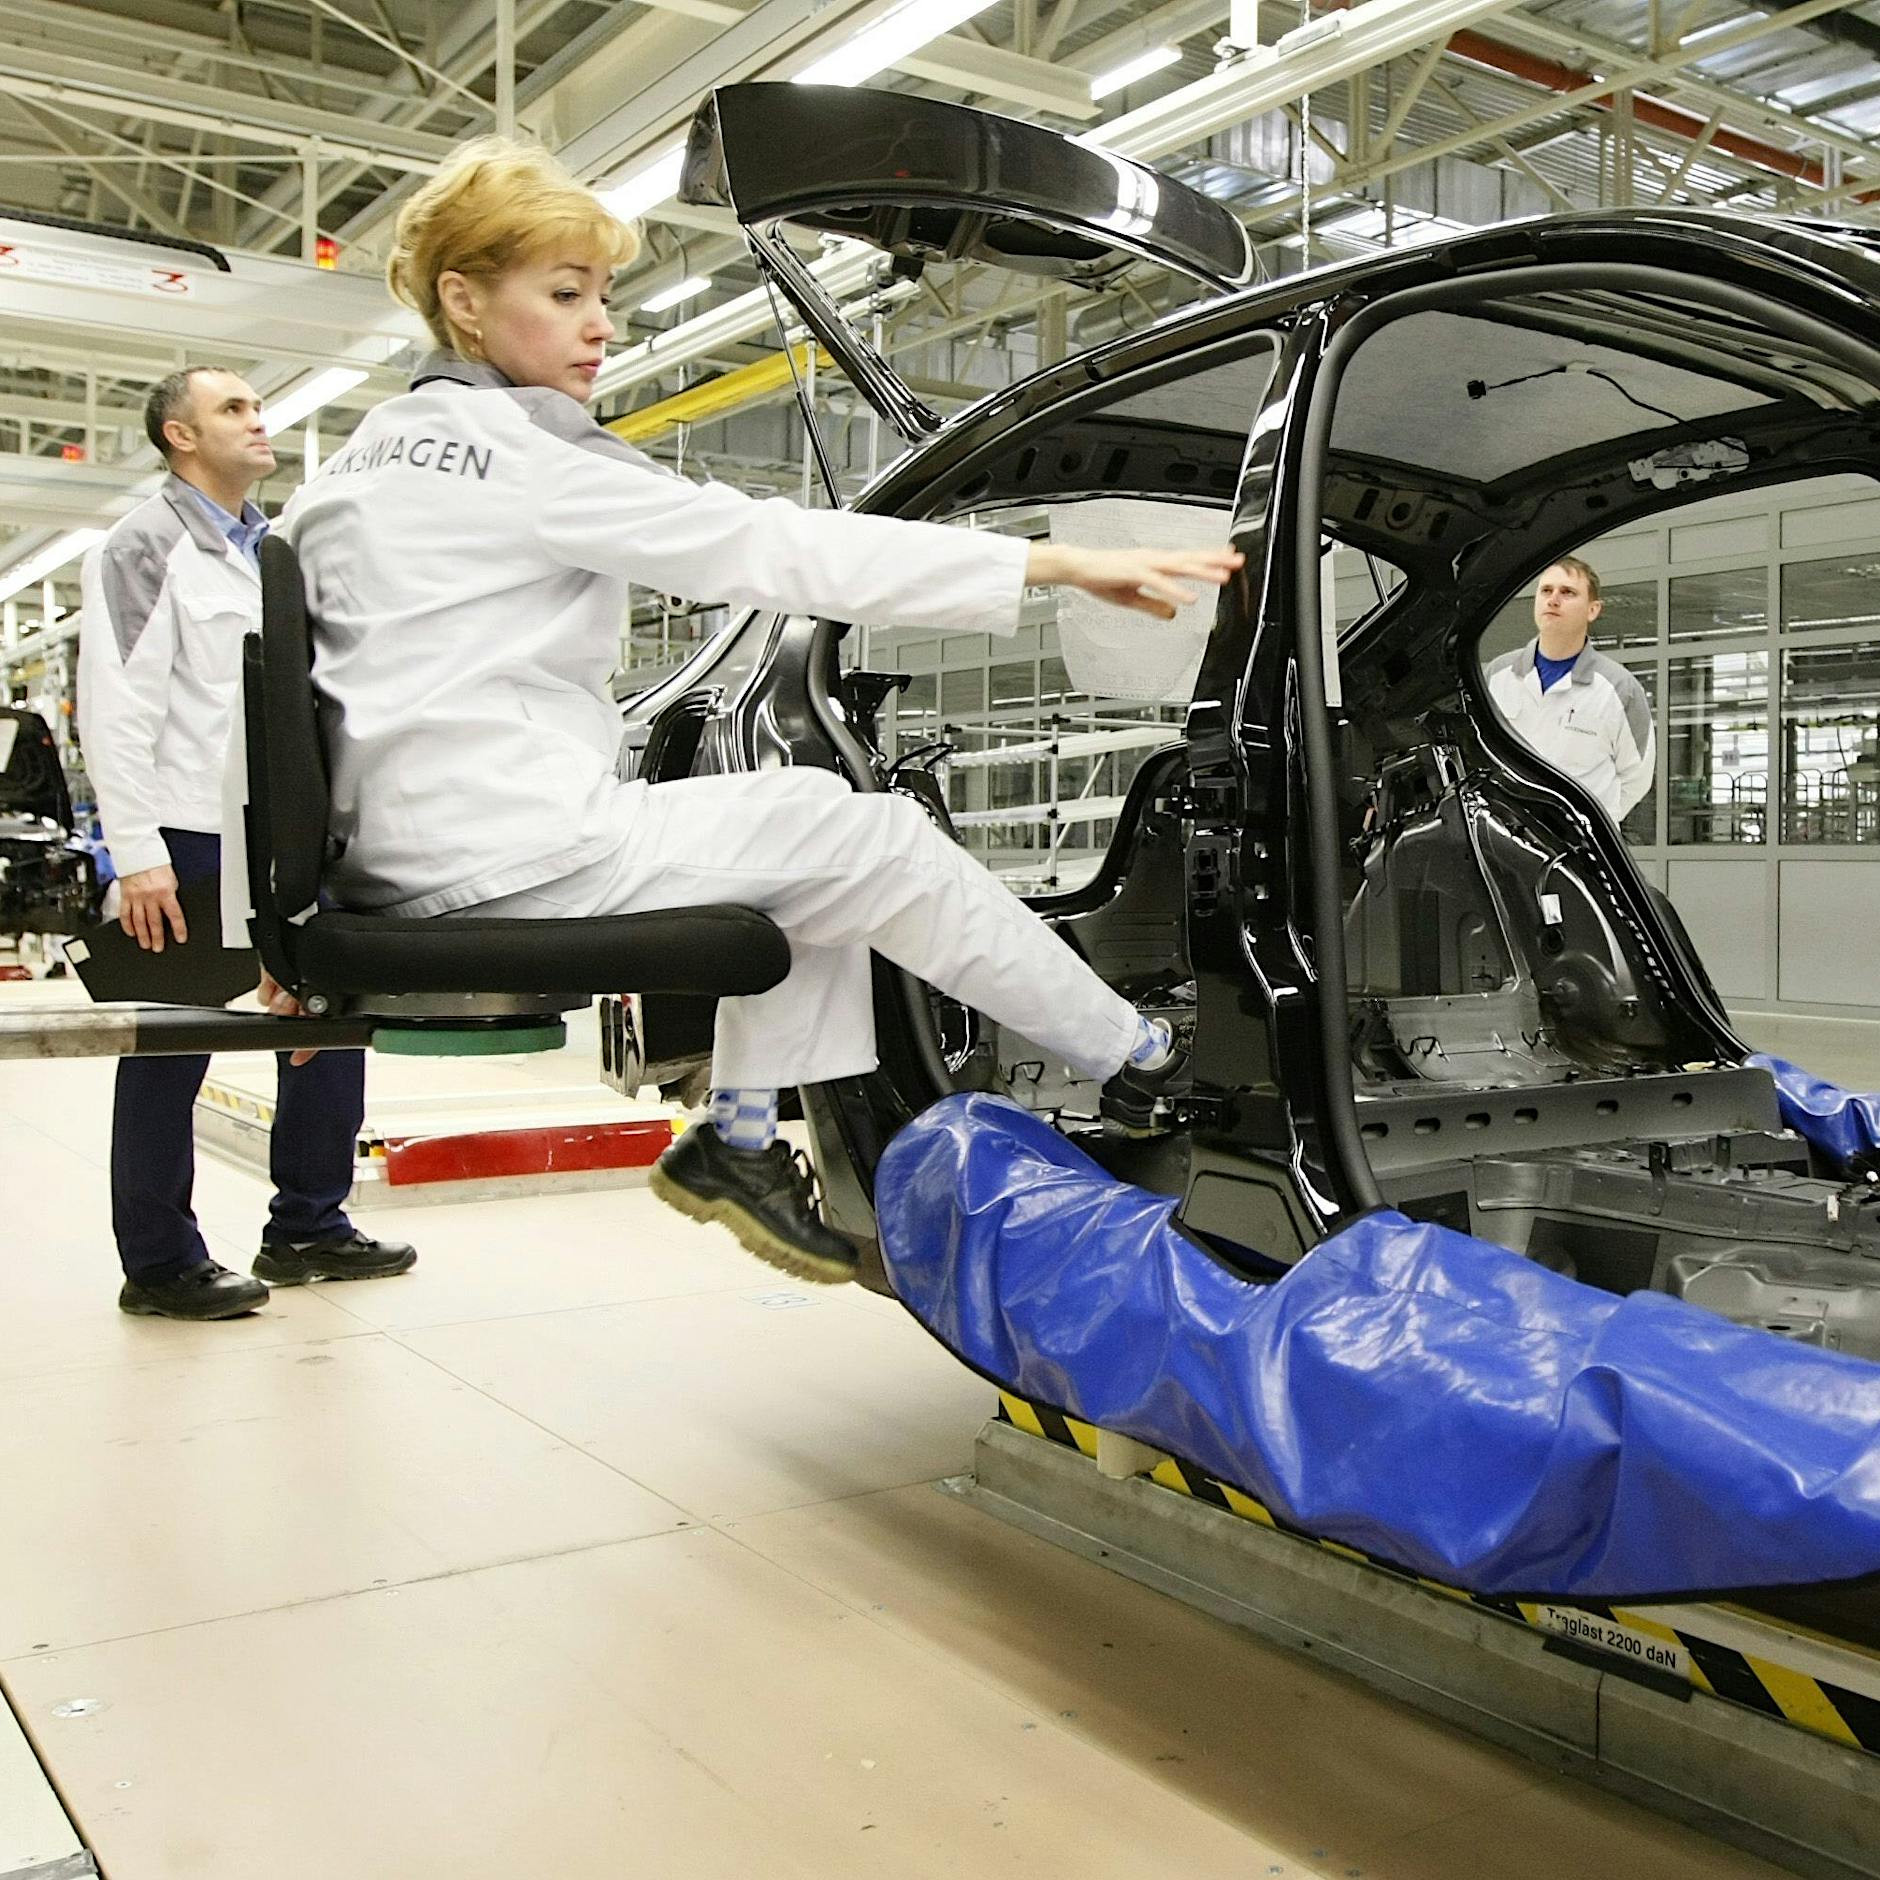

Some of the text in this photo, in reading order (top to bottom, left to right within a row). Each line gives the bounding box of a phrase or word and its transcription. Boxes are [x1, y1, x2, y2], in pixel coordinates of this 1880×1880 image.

[1547, 1607, 1677, 1669] Taglast 2200 daN
